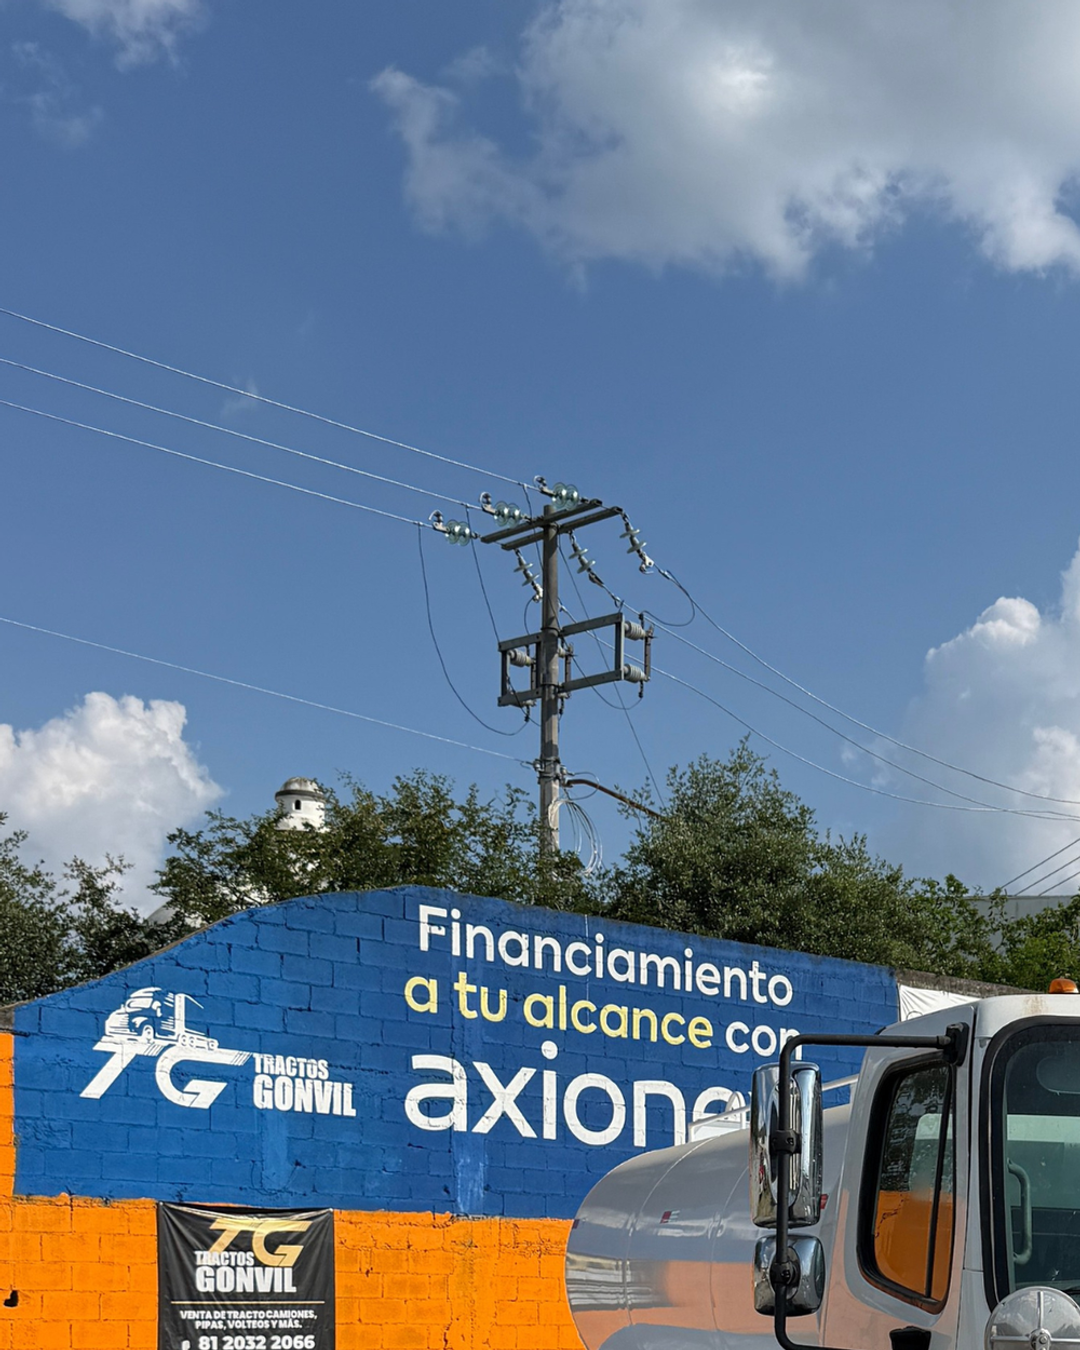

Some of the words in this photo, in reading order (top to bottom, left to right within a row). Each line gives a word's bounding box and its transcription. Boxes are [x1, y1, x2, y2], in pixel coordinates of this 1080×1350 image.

[418, 904, 793, 1007] Financiamiento
[404, 976, 438, 1014] a
[453, 971, 508, 1022] tu
[523, 984, 713, 1049] alcance
[726, 1021, 802, 1061] con
[252, 1053, 329, 1080] TRACTOS
[253, 1074, 357, 1117] GONVIL
[209, 1218, 314, 1267] TG
[194, 1251, 254, 1266] TRACTOS
[195, 1266, 297, 1293] GONVIL
[180, 1310, 212, 1320] VENTA
[213, 1311, 226, 1320] DE
[195, 1320, 226, 1330] PIPAS,
[227, 1320, 269, 1329] VOLTEOS
[270, 1320, 278, 1328] Y
[278, 1318, 302, 1328] MÁS.
[199, 1336, 218, 1350] 81
[222, 1336, 266, 1350] 2032
[270, 1335, 315, 1350] 2066
